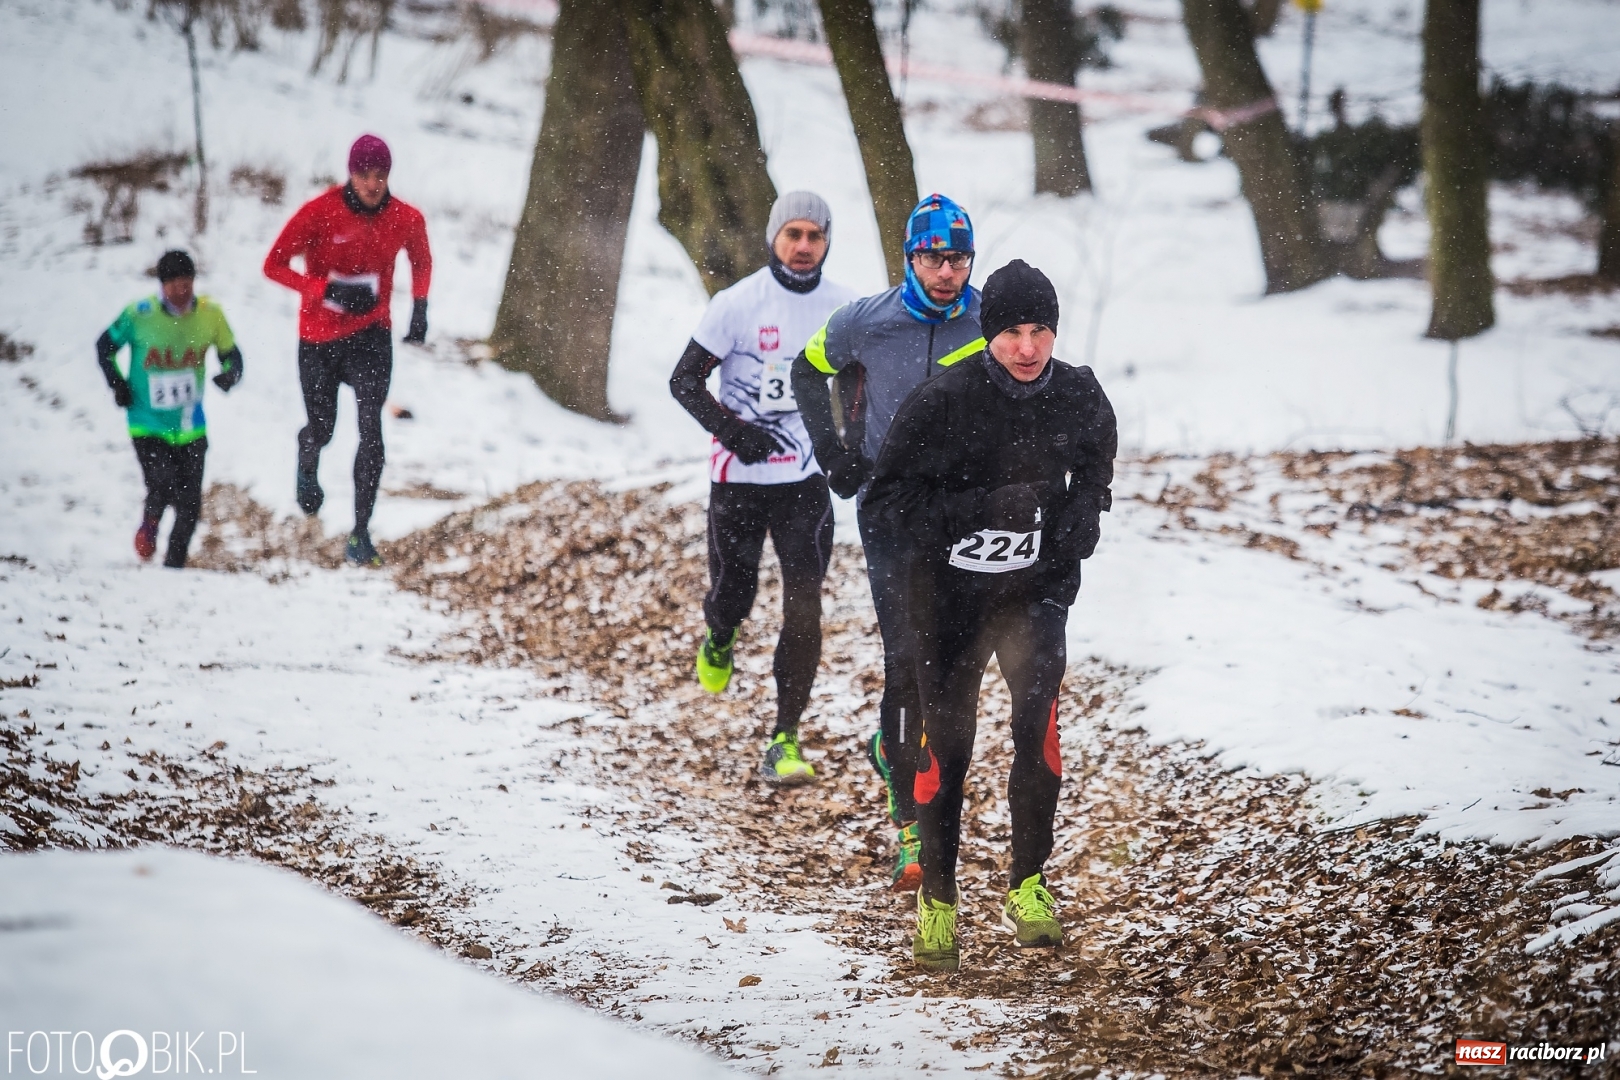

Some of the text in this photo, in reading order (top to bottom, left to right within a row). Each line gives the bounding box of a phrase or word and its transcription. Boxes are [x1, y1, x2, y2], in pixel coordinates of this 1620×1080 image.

[154, 382, 192, 403] 211
[767, 378, 795, 400] 3
[957, 532, 1035, 561] 224
